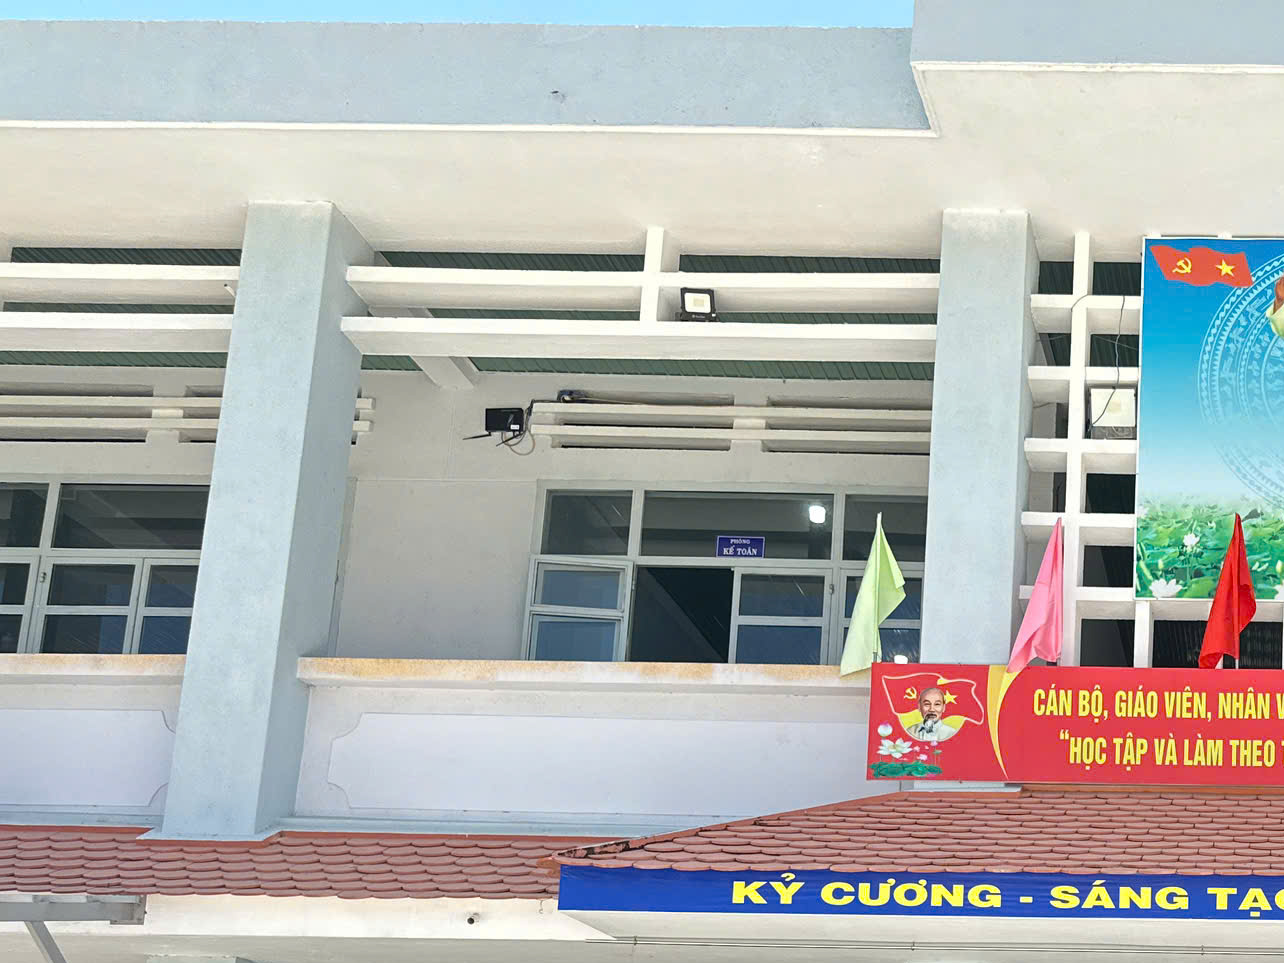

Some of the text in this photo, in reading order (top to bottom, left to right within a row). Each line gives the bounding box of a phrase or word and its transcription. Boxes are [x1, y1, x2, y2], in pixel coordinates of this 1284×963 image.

[723, 545, 758, 556] KẾ TOÁN
[1033, 684, 1073, 716] CÁN
[1078, 684, 1108, 724] BỘ,
[1115, 686, 1158, 718] GIÁO
[1164, 686, 1212, 722] VIÊN,
[1218, 687, 1271, 719] NHÂN
[1059, 730, 1107, 770] “HỌC
[1113, 730, 1148, 772] TẬP
[1154, 732, 1177, 766] VÀ
[1183, 733, 1223, 766] LÀM
[1230, 738, 1275, 767] THEO
[732, 872, 804, 905] KỶ
[820, 878, 1002, 908] CƯƠNG
[1050, 879, 1189, 910] SÁNG
